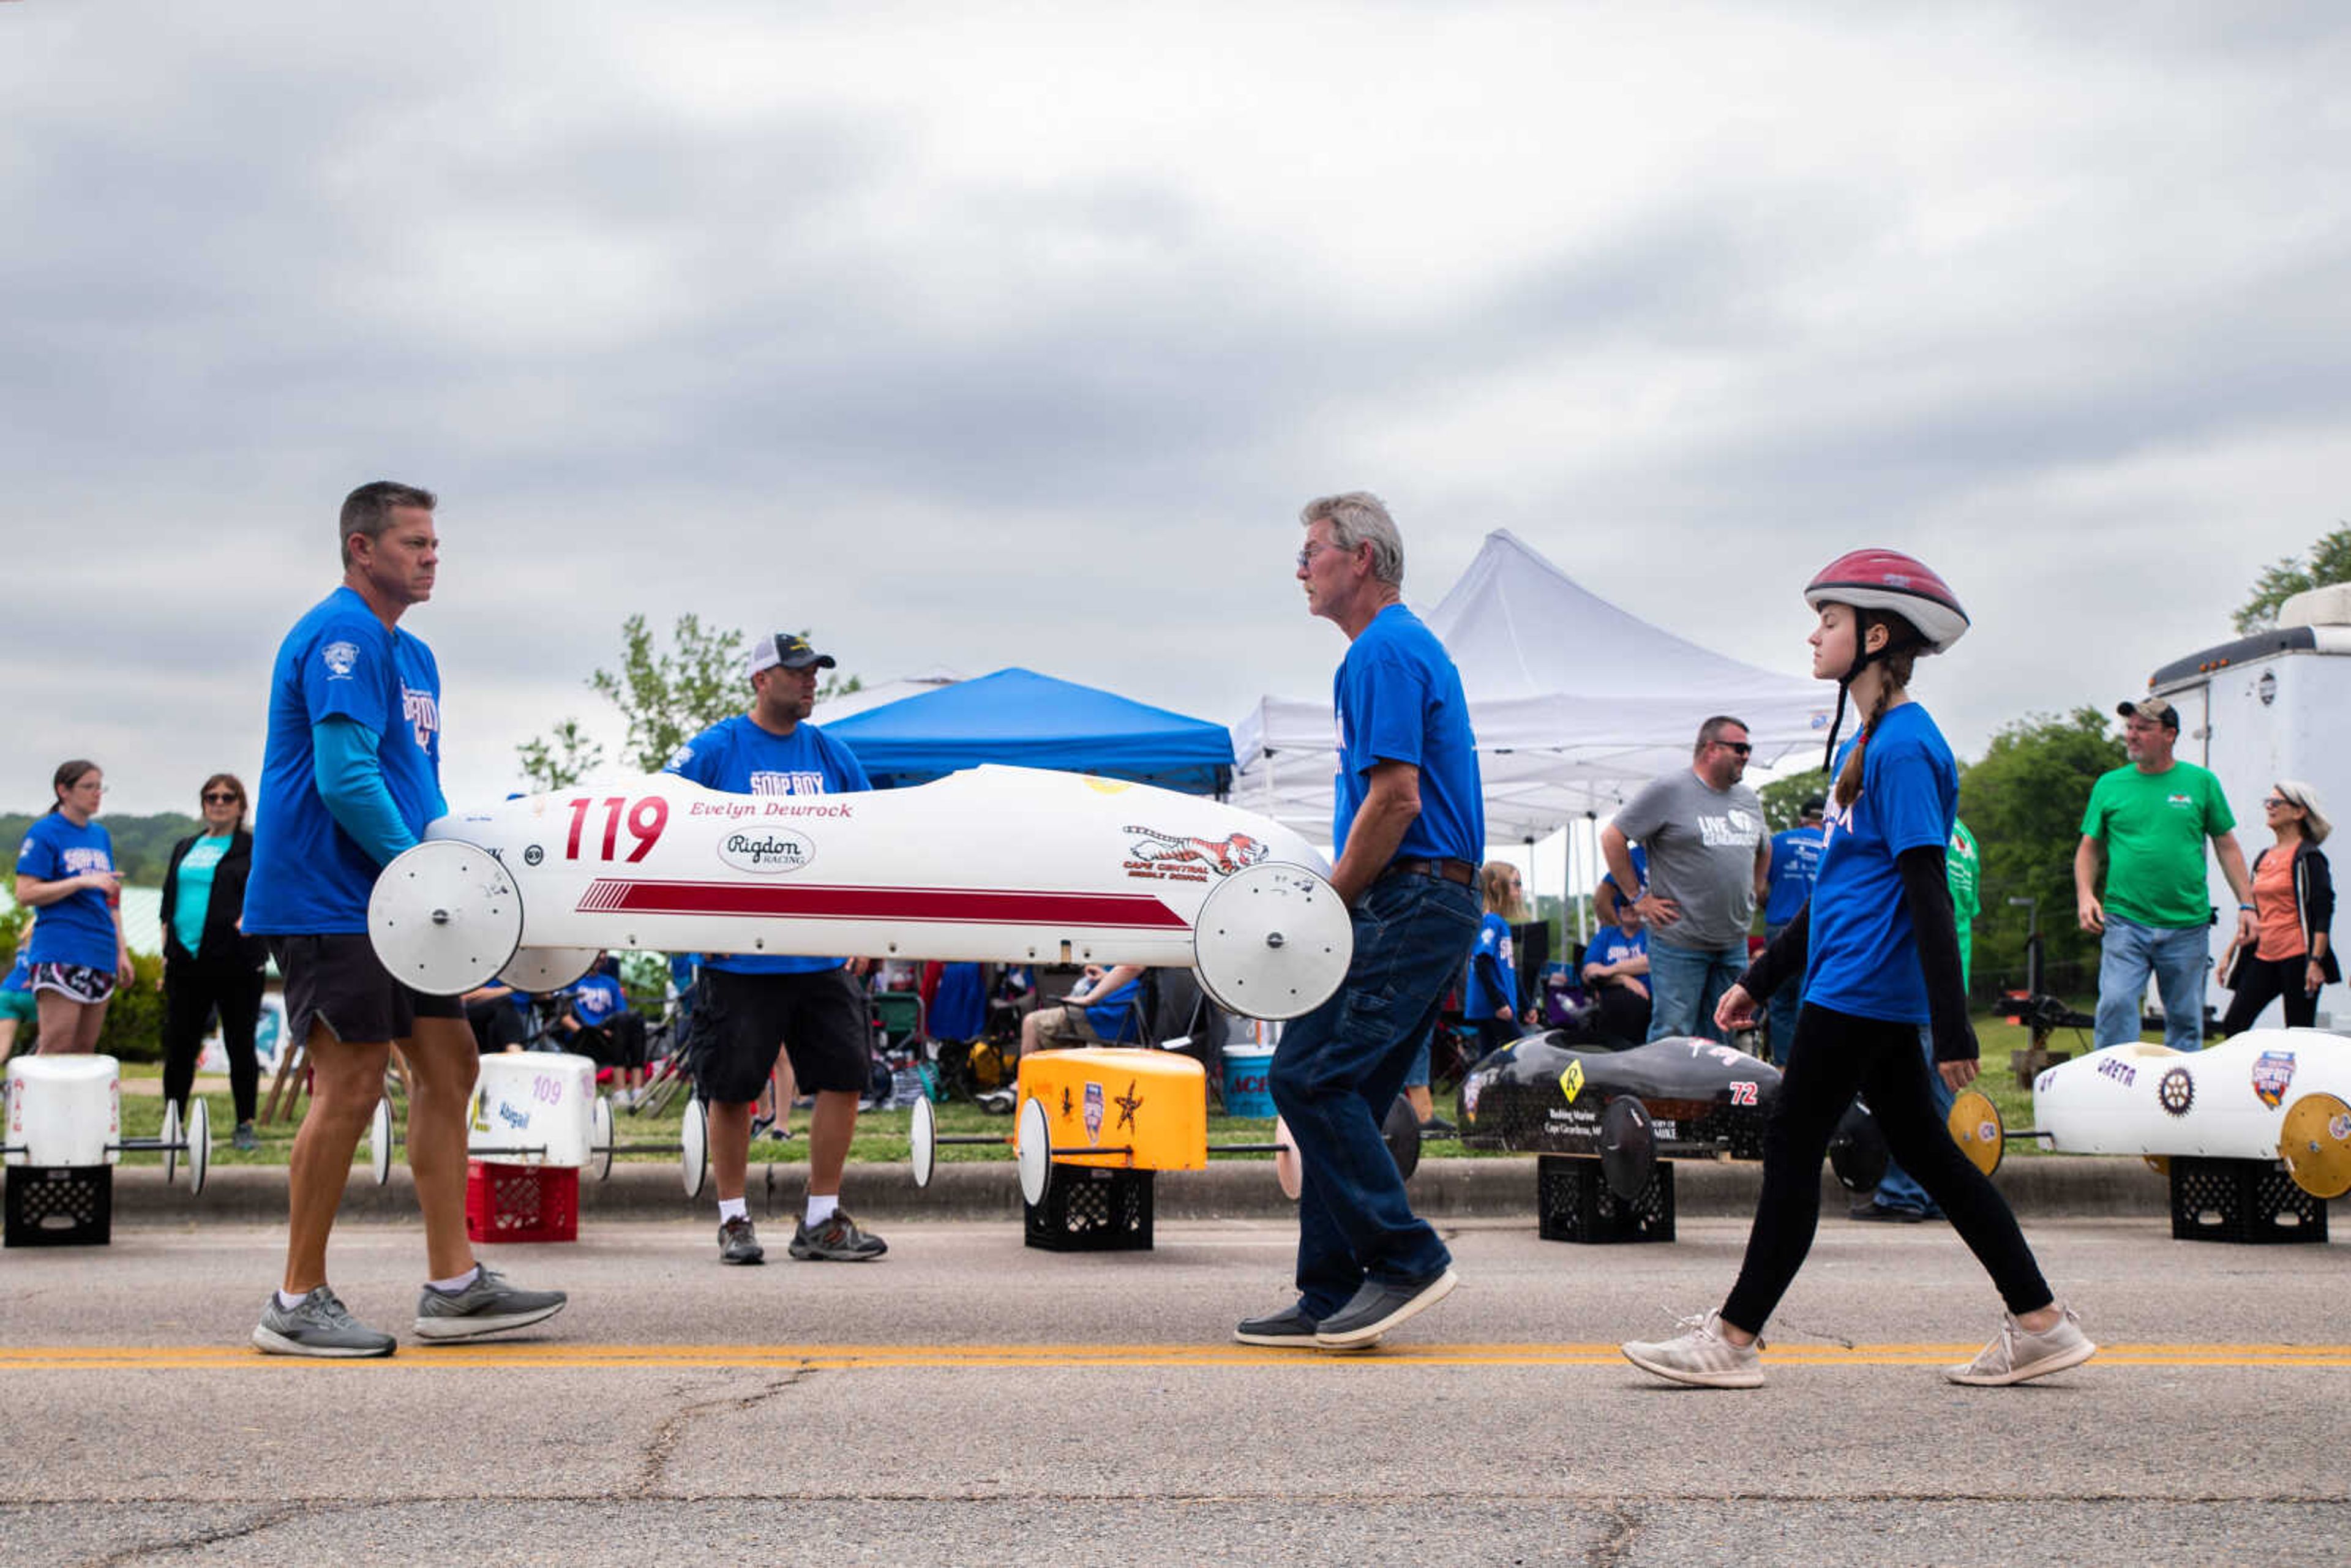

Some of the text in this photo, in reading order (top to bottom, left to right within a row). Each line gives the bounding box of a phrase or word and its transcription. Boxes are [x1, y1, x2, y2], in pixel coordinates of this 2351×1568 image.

[792, 775, 823, 796] BOX
[689, 803, 853, 818] Evelyn Dewrock
[566, 796, 669, 863] 119
[727, 834, 801, 864] Rigdon
[763, 855, 806, 865] RACING
[1123, 861, 1209, 874] CAPE CENTRAL
[533, 1075, 562, 1106] 109
[1730, 1081, 1758, 1106] 72
